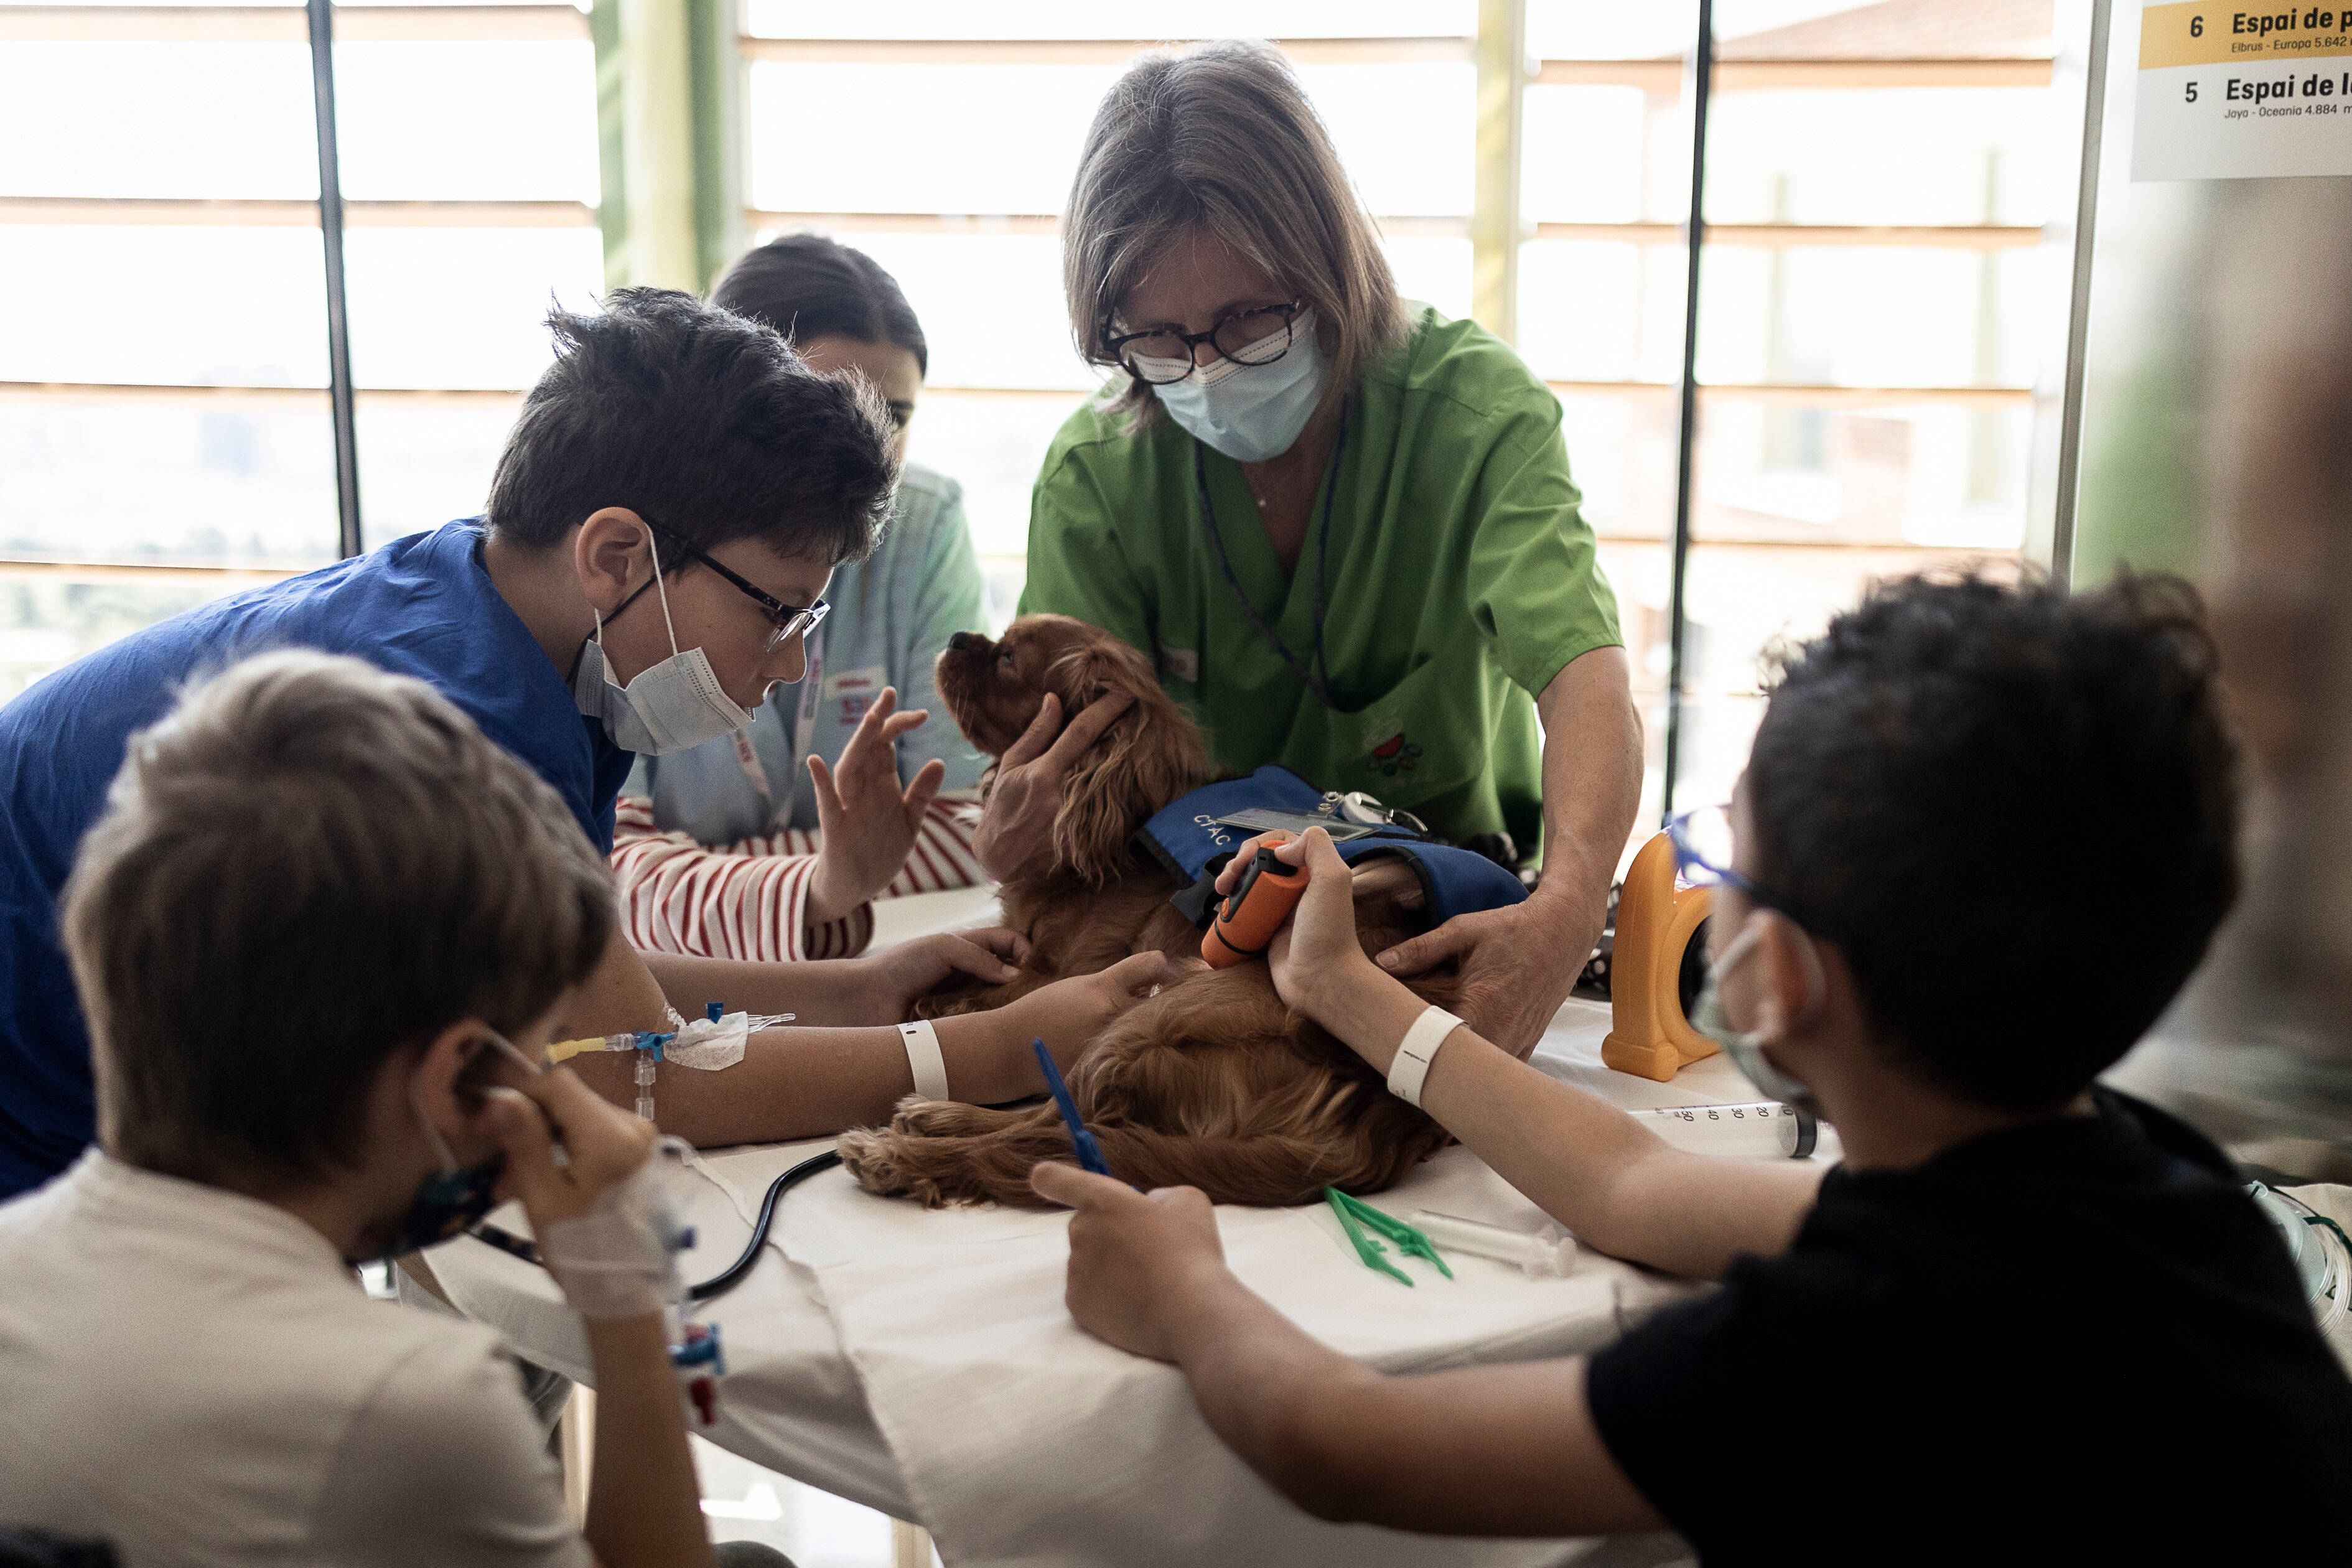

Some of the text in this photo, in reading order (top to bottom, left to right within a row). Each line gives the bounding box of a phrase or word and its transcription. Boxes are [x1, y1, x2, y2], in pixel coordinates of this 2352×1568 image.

[2190, 16, 2204, 37] 6
[2233, 7, 2297, 37] Espai
[2303, 7, 2333, 29] de
[2231, 42, 2263, 53] Elbrus
[2274, 39, 2311, 50] Europa
[2314, 36, 2347, 48] 5.642
[2185, 72, 2352, 105] 5 Espai de l
[2224, 109, 2249, 119] Jaya
[2259, 106, 2302, 117] Oceania
[2305, 105, 2337, 114] 4.884
[1194, 814, 1231, 846] CTAC
[1681, 1111, 1694, 1122] 50
[1707, 1109, 1719, 1121] 40
[1732, 1108, 1745, 1119] 30
[1756, 1106, 1769, 1118] 20
